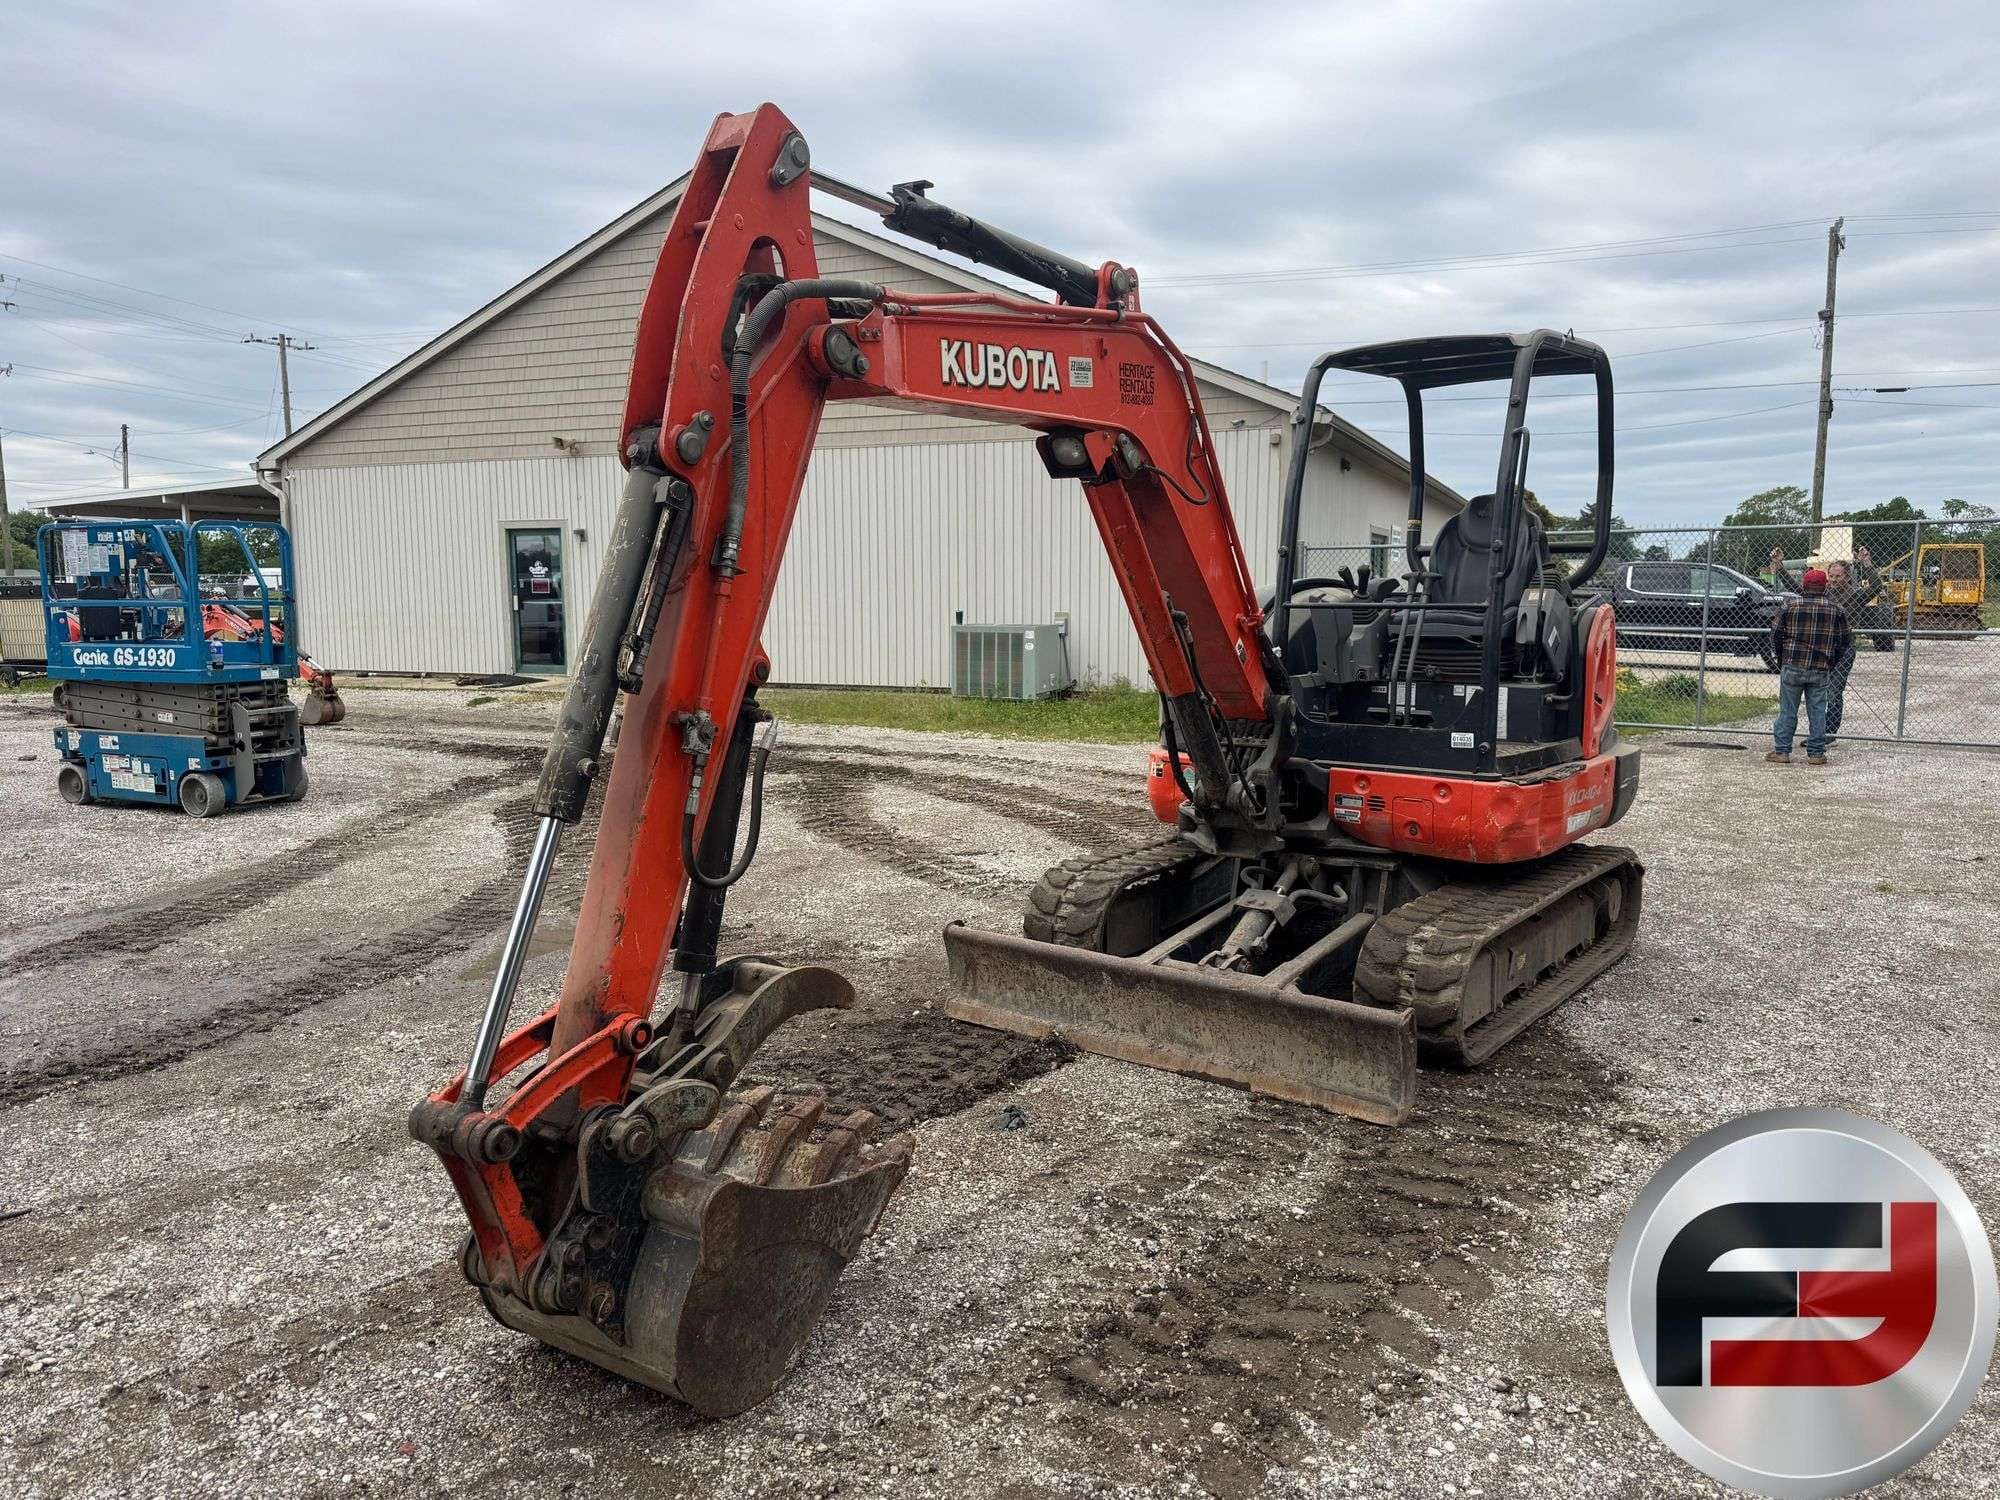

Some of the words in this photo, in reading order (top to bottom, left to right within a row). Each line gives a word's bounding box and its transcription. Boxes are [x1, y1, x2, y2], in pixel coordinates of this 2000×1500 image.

[940, 338, 1061, 393] KUBOTA
[1119, 362, 1154, 380] HERITAGE
[1120, 378, 1154, 395] RENTALS
[73, 648, 109, 665] Genie
[113, 648, 176, 667] GS-1930
